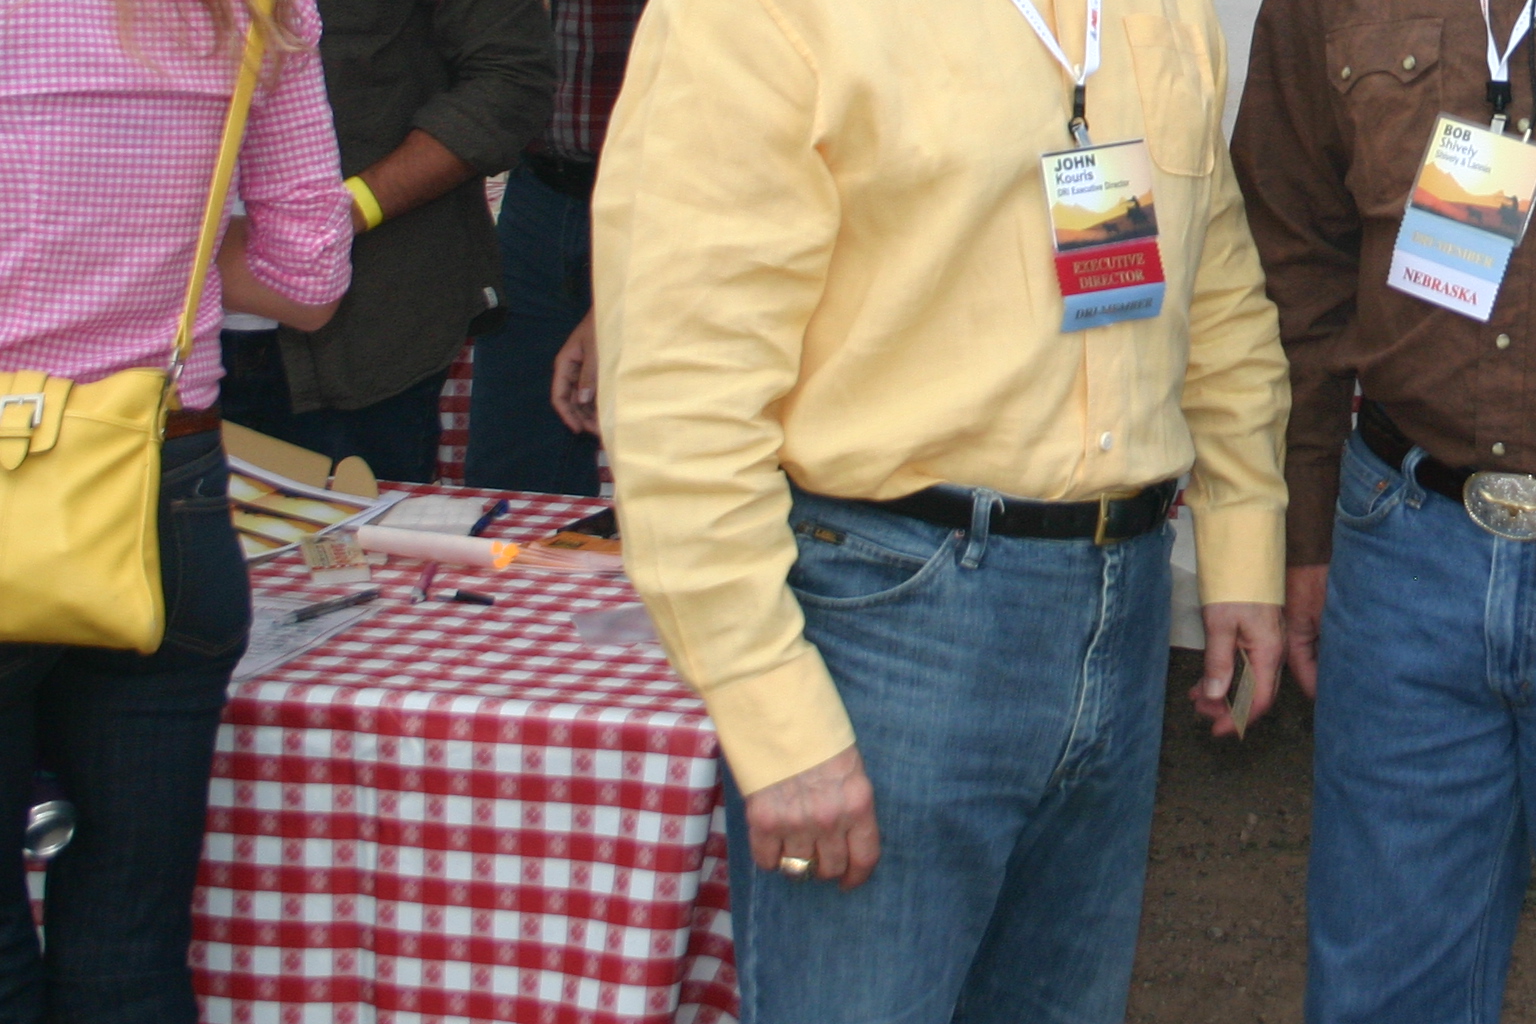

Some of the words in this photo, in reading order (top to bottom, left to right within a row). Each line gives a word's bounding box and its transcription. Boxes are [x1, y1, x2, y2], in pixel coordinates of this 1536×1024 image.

[1443, 123, 1472, 142] BOB
[1439, 136, 1479, 160] Shively
[1054, 153, 1096, 172] JOHN
[1072, 252, 1146, 274] EXECUTIVE
[1079, 269, 1146, 290] DIRECTOR
[1403, 266, 1478, 306] NEBRASKA
